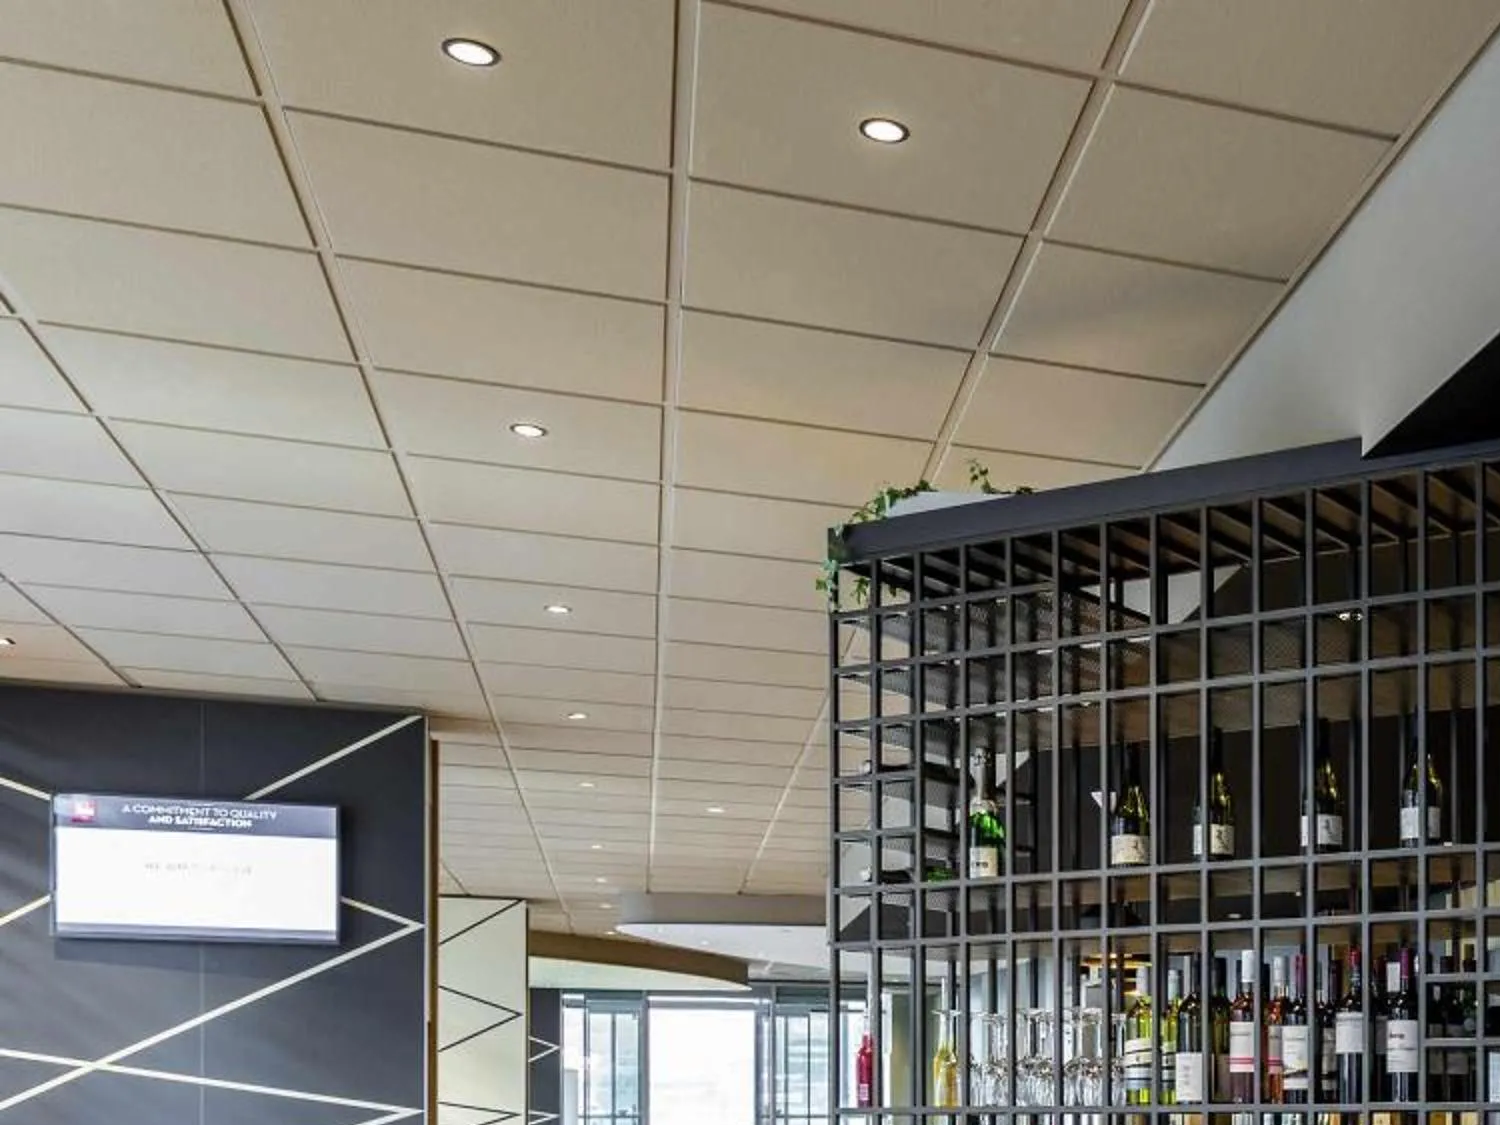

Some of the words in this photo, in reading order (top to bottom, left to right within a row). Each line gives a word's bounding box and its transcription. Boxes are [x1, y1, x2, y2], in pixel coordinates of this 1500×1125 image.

[121, 804, 131, 813] A
[132, 804, 210, 817] COMMITMENT
[212, 808, 228, 818] TO
[230, 809, 278, 820] QUALITY
[148, 815, 173, 825] AND
[175, 816, 253, 828] SATISFACTION
